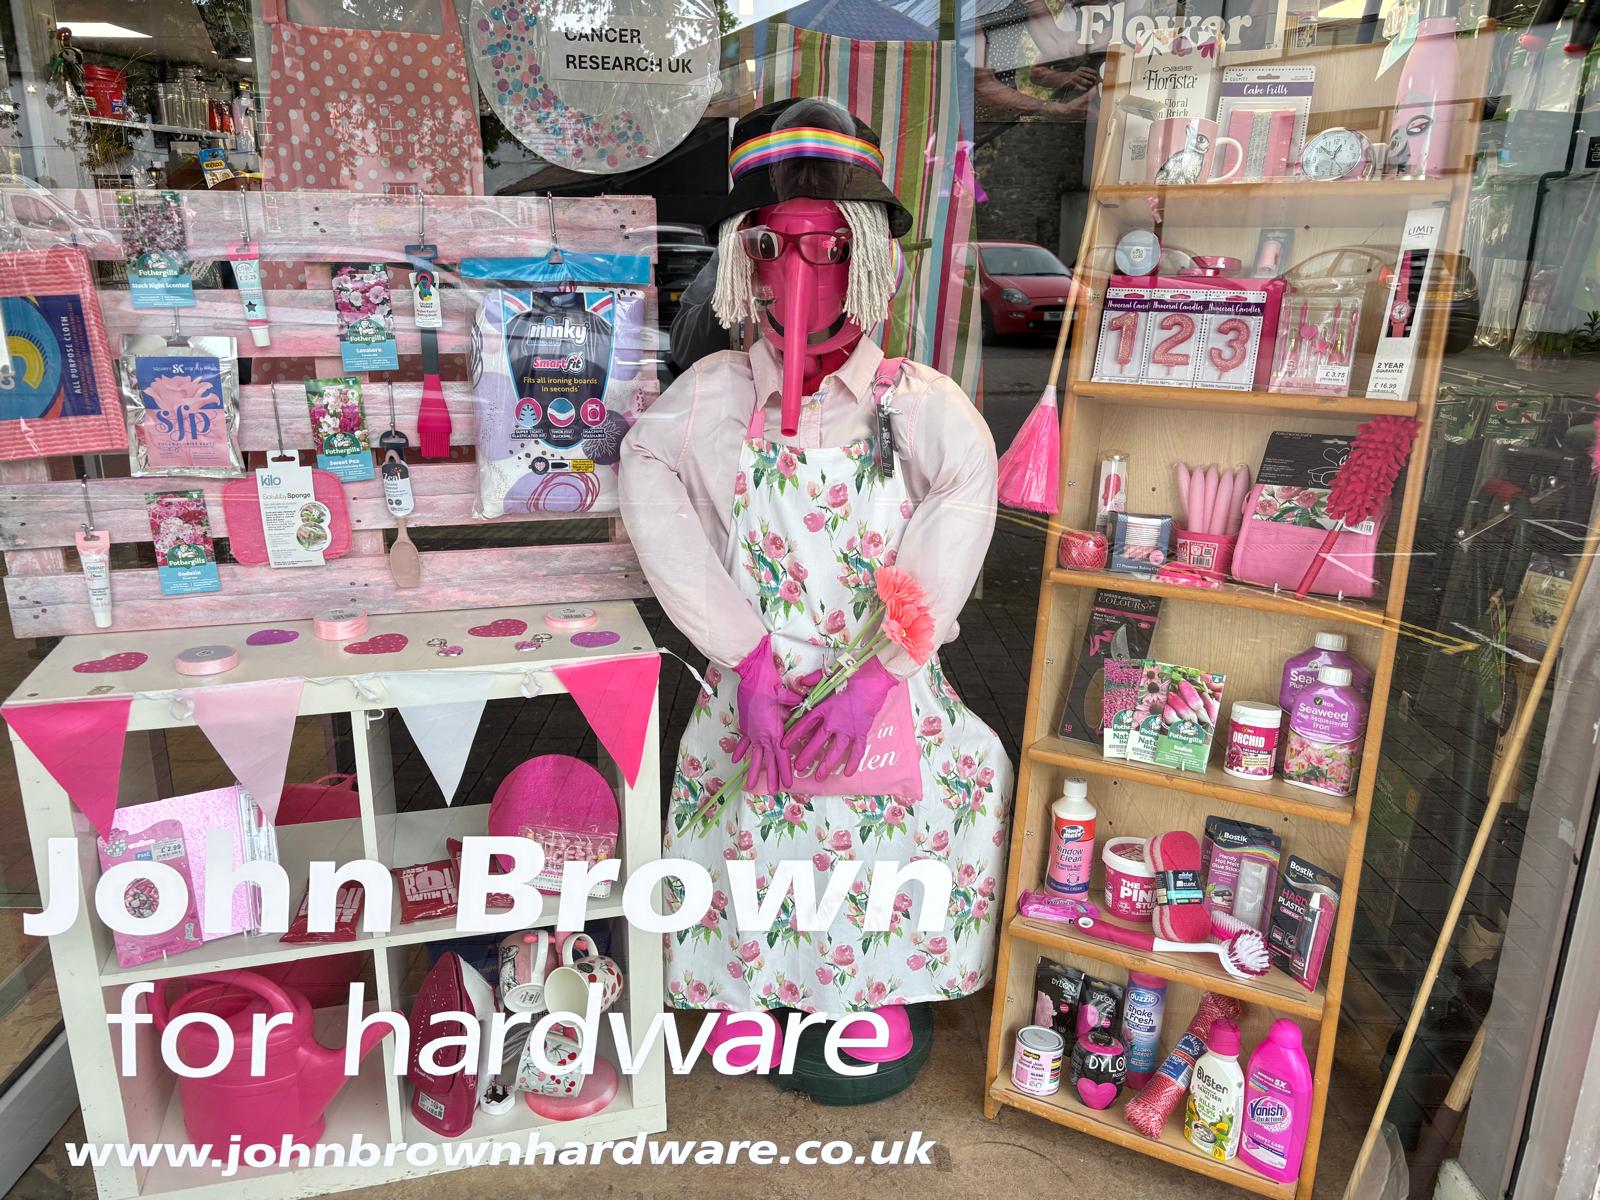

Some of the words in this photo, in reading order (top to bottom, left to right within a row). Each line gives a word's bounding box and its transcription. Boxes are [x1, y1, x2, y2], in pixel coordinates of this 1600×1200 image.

[1077, 2, 1252, 45] Flower
[565, 27, 642, 44] CANCER
[565, 54, 662, 72] RESEARCH
[668, 58, 692, 73] UK
[1145, 69, 1196, 91] Florista
[1243, 84, 1265, 95] Cake
[1266, 85, 1288, 95] Frills
[1408, 224, 1435, 236] LIMIT
[1179, 302, 1204, 311] Candles
[1236, 304, 1261, 313] Candles
[61, 316, 72, 342] CLOTH
[530, 316, 588, 345] minky
[350, 335, 385, 343] Fothergills
[1151, 313, 1195, 366] 2
[1210, 318, 1250, 373] 3
[66, 343, 79, 383] PURPOSE
[547, 377, 573, 385] ironing
[74, 383, 82, 394] ALL
[541, 385, 549, 393] in
[325, 446, 361, 455] Fothergills
[261, 474, 281, 486] kilo
[169, 558, 206, 567] Fothergills
[1098, 596, 1147, 610] COLOURS
[1290, 671, 1316, 683] Sea
[1299, 702, 1349, 721] Seaweed
[877, 722, 896, 739] in
[1313, 721, 1330, 731] Iron
[1138, 736, 1156, 746] Natu
[1169, 733, 1202, 744] Fothergills
[1232, 730, 1266, 748] ORCHID
[1224, 832, 1248, 843] Bostik
[1059, 853, 1082, 862] Clean
[1219, 853, 1238, 862] Handy
[1290, 860, 1315, 879] Bostik
[23, 830, 393, 936] John
[455, 835, 954, 934] Brown
[1120, 878, 1140, 888] THE
[1282, 887, 1308, 906] HARD
[1135, 902, 1157, 910] STU
[1278, 895, 1305, 914] PLASTIC
[1051, 977, 1075, 992] DYLON
[1130, 992, 1156, 1004] duzzit
[1127, 1004, 1153, 1017] Shake
[1129, 1013, 1154, 1025] Fresh
[106, 982, 294, 1079] for
[343, 982, 890, 1077] hardware
[1196, 1065, 1228, 1094] Buster
[1250, 1097, 1284, 1120] Vanish
[65, 1130, 936, 1176] www.johnbrownhardware.co.uk
